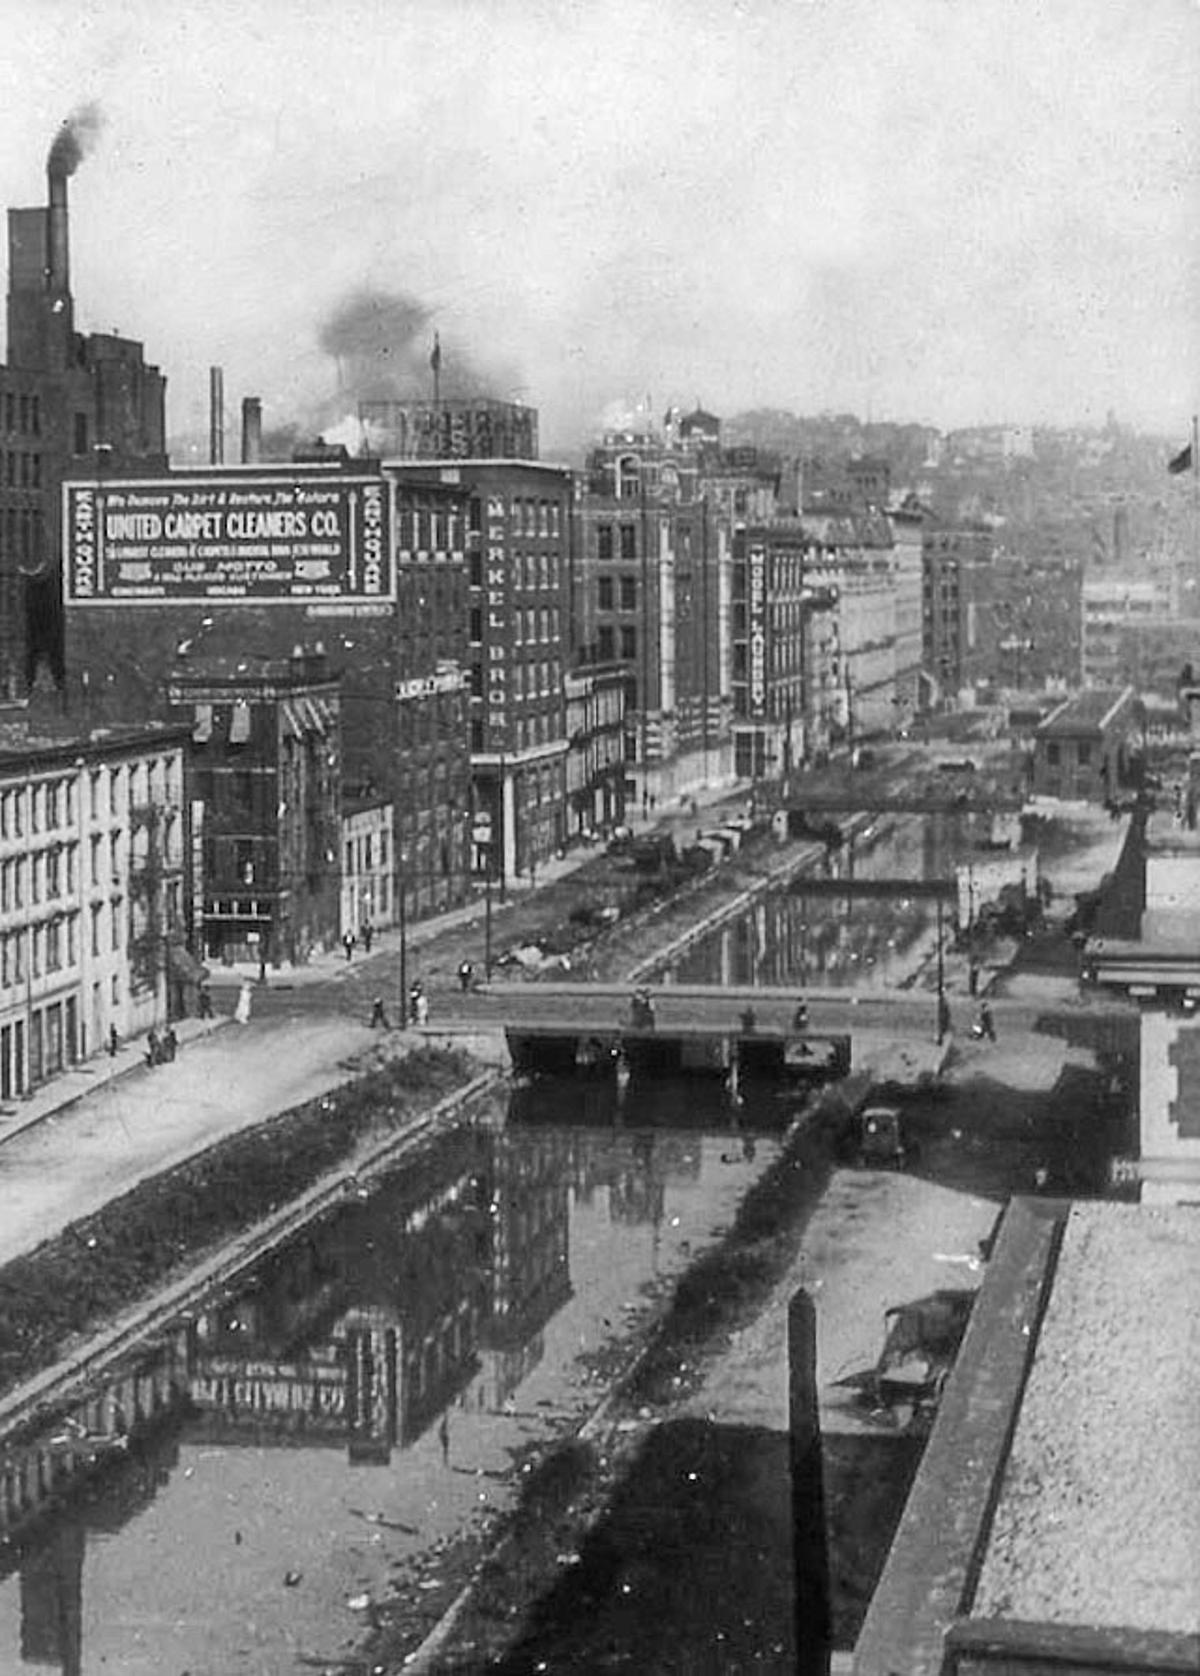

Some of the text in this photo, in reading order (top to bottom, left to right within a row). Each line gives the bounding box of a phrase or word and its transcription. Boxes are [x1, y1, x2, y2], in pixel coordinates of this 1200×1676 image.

[106, 513, 162, 540] UNITED
[164, 511, 223, 540] CARPET
[226, 511, 307, 538] CLEANERS
[217, 560, 278, 573] MOTTO
[487, 501, 505, 628] MERKEL
